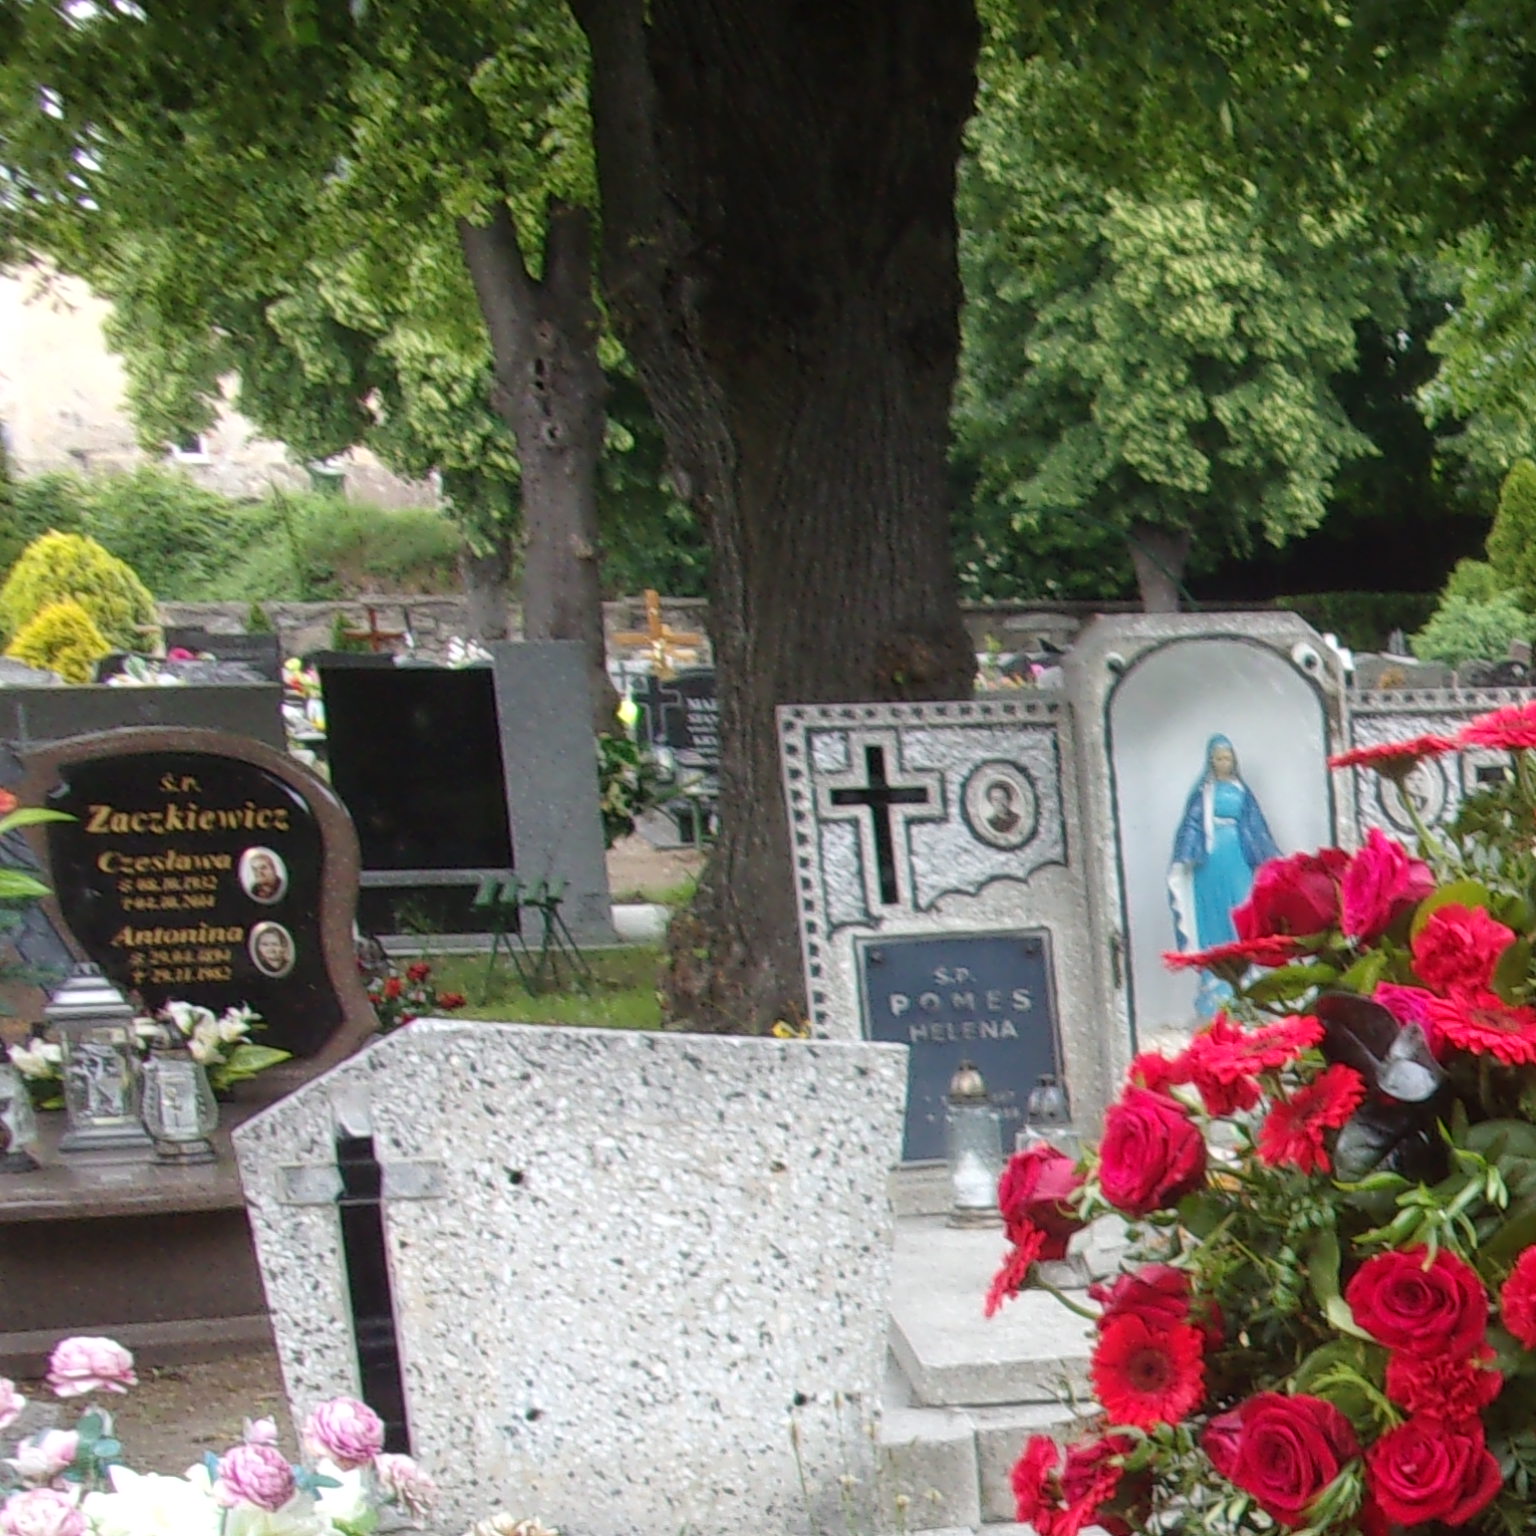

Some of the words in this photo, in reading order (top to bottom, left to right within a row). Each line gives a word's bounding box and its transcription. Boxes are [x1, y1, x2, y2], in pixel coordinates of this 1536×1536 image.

[85, 802, 290, 835] Zaczkiewicz
[110, 921, 245, 947] Antonina
[889, 987, 1033, 1017] POMES
[908, 1018, 1020, 1042] HELENA
